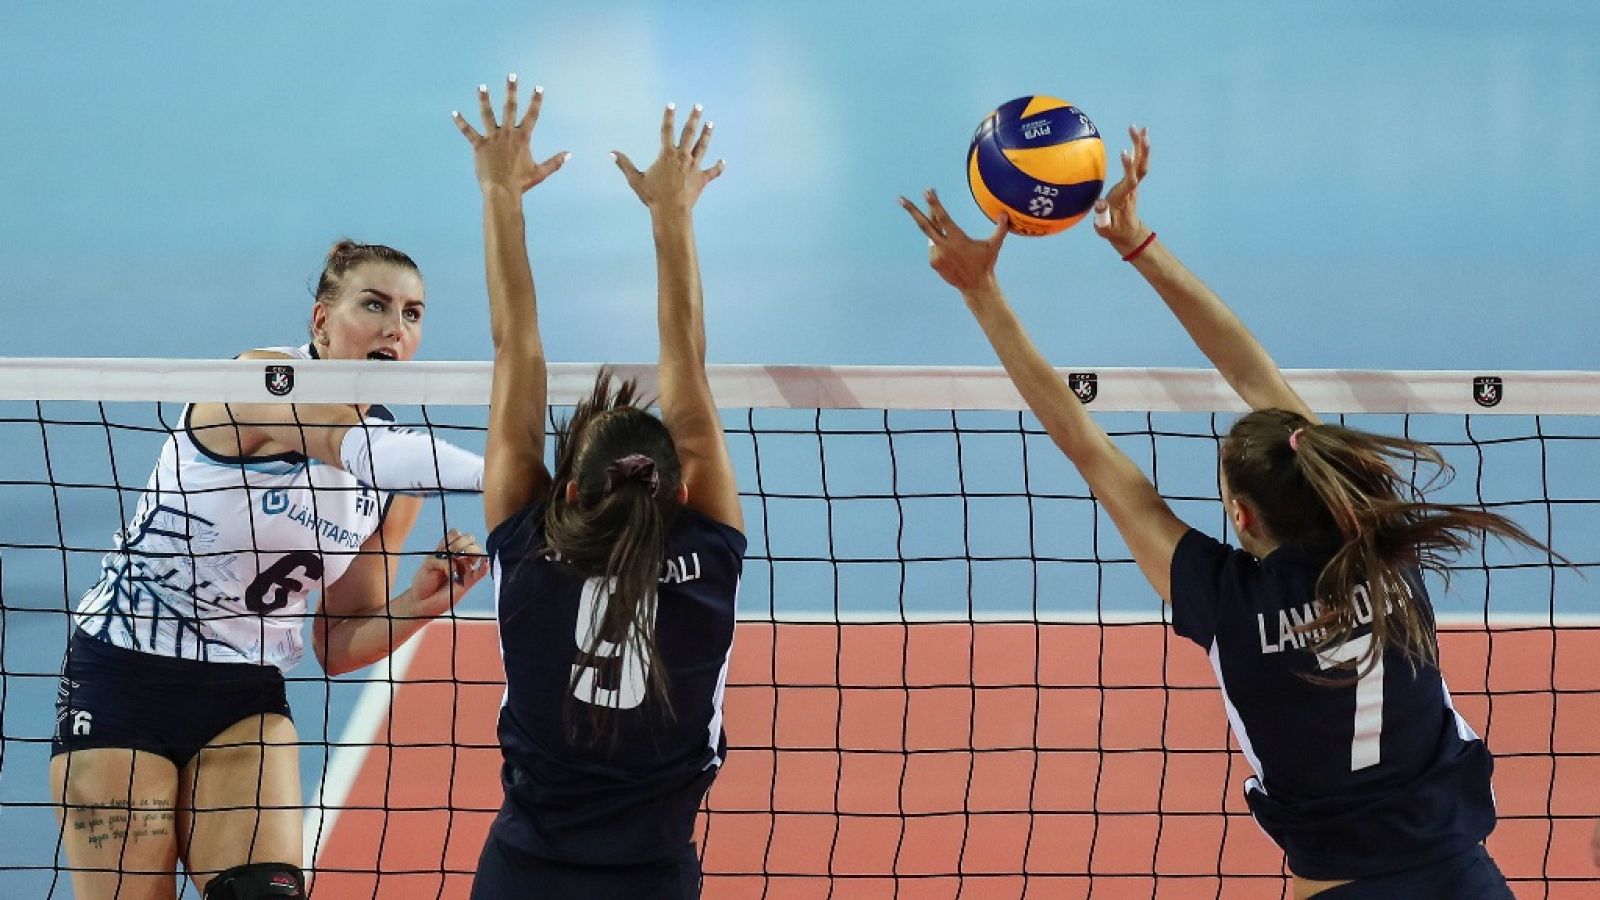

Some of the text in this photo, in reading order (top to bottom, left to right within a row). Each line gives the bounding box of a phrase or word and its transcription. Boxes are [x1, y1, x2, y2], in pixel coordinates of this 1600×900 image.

[1024, 126, 1051, 140] FIVB
[1033, 184, 1059, 197] CEV
[245, 551, 323, 614] 6
[569, 575, 659, 710] 9
[1316, 632, 1384, 772] 7
